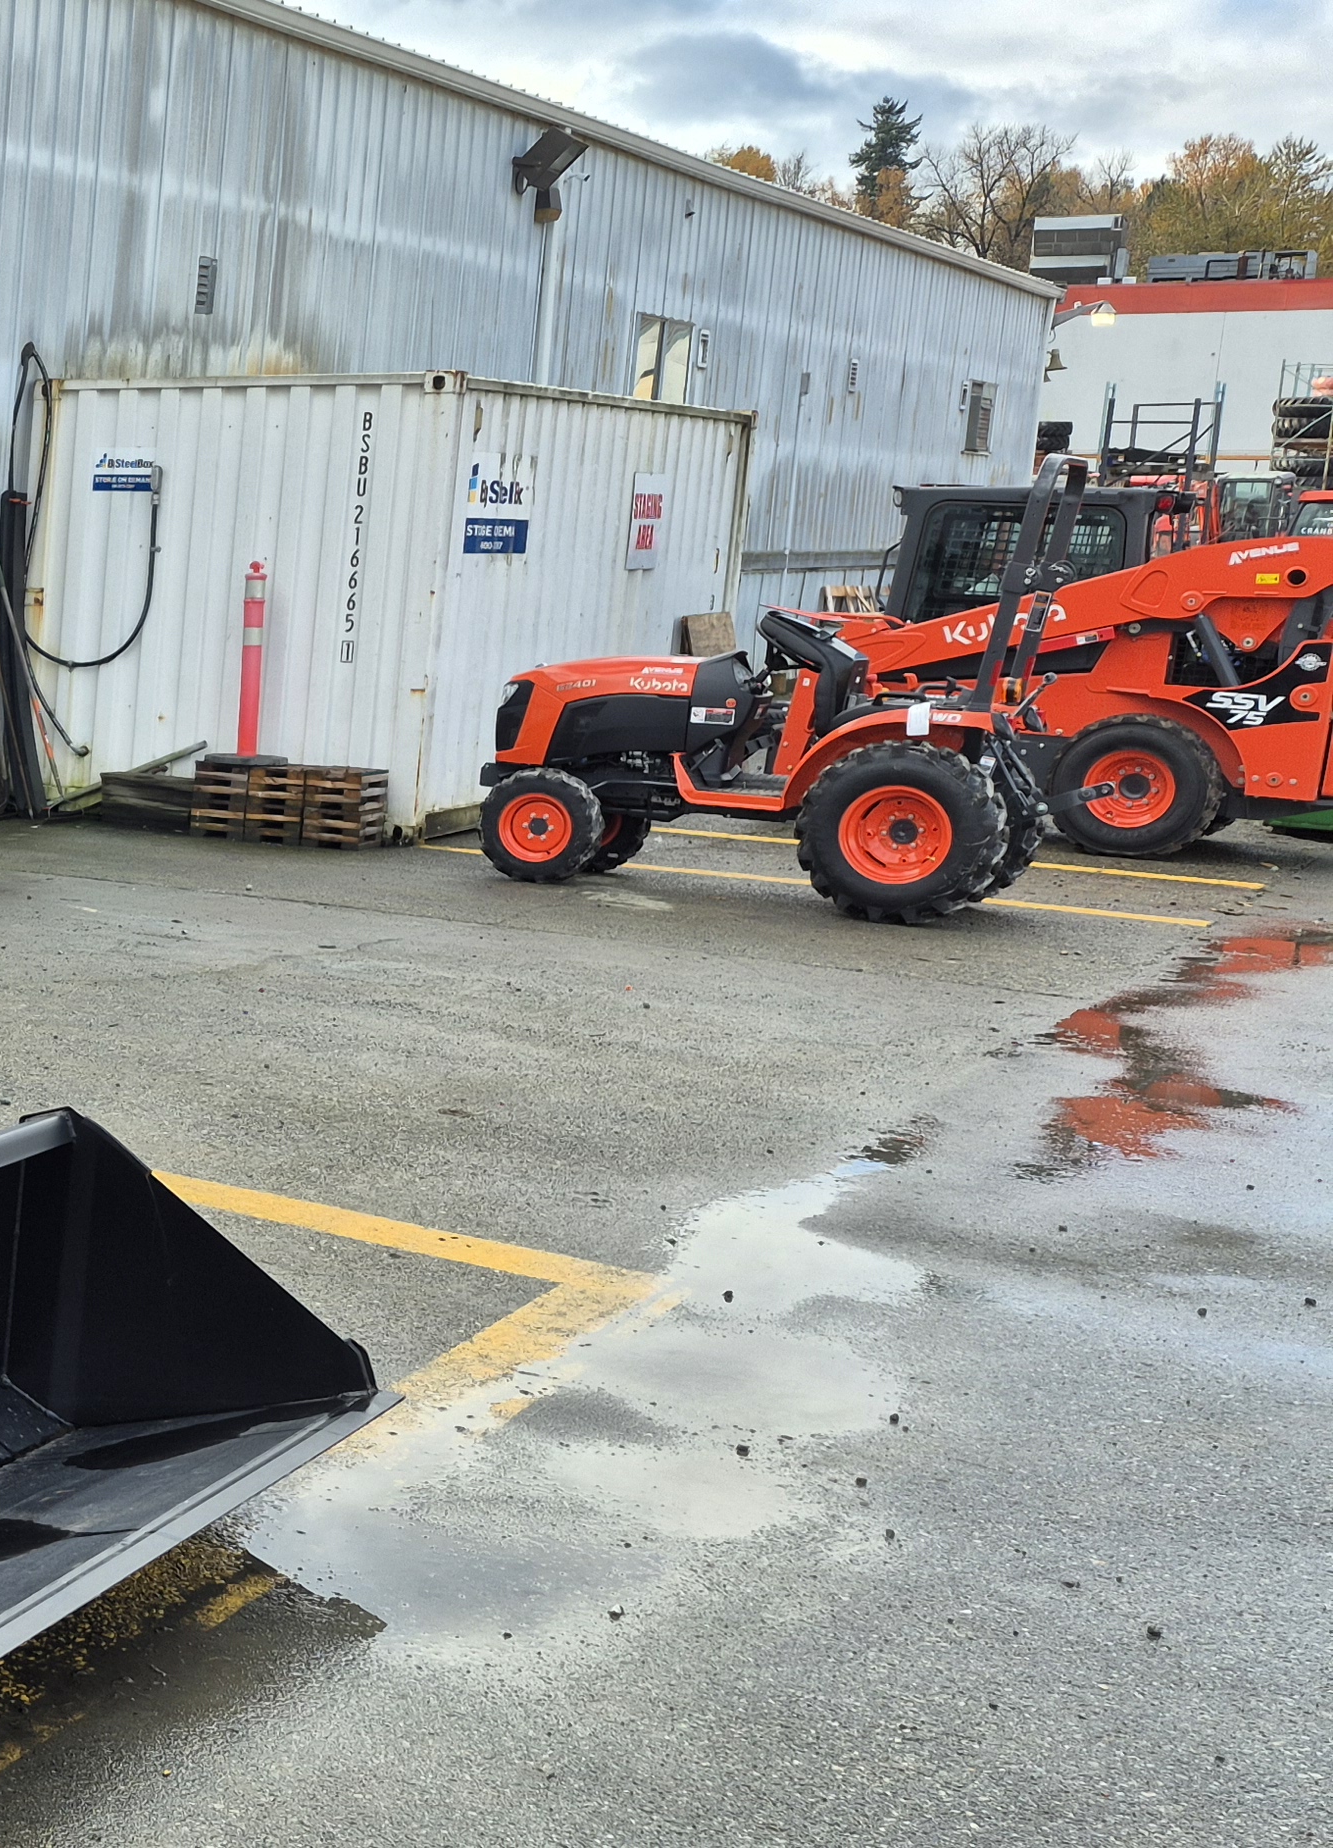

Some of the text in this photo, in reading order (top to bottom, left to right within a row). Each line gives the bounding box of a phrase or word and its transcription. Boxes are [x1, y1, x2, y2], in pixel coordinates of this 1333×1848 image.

[356, 411, 373, 497] BSBU
[1228, 541, 1300, 566] AVENUE
[344, 504, 364, 633] 216665
[629, 677, 689, 693] Kubota
[1205, 691, 1286, 712] SSV
[929, 711, 962, 723] WD
[1225, 709, 1267, 726] 75
